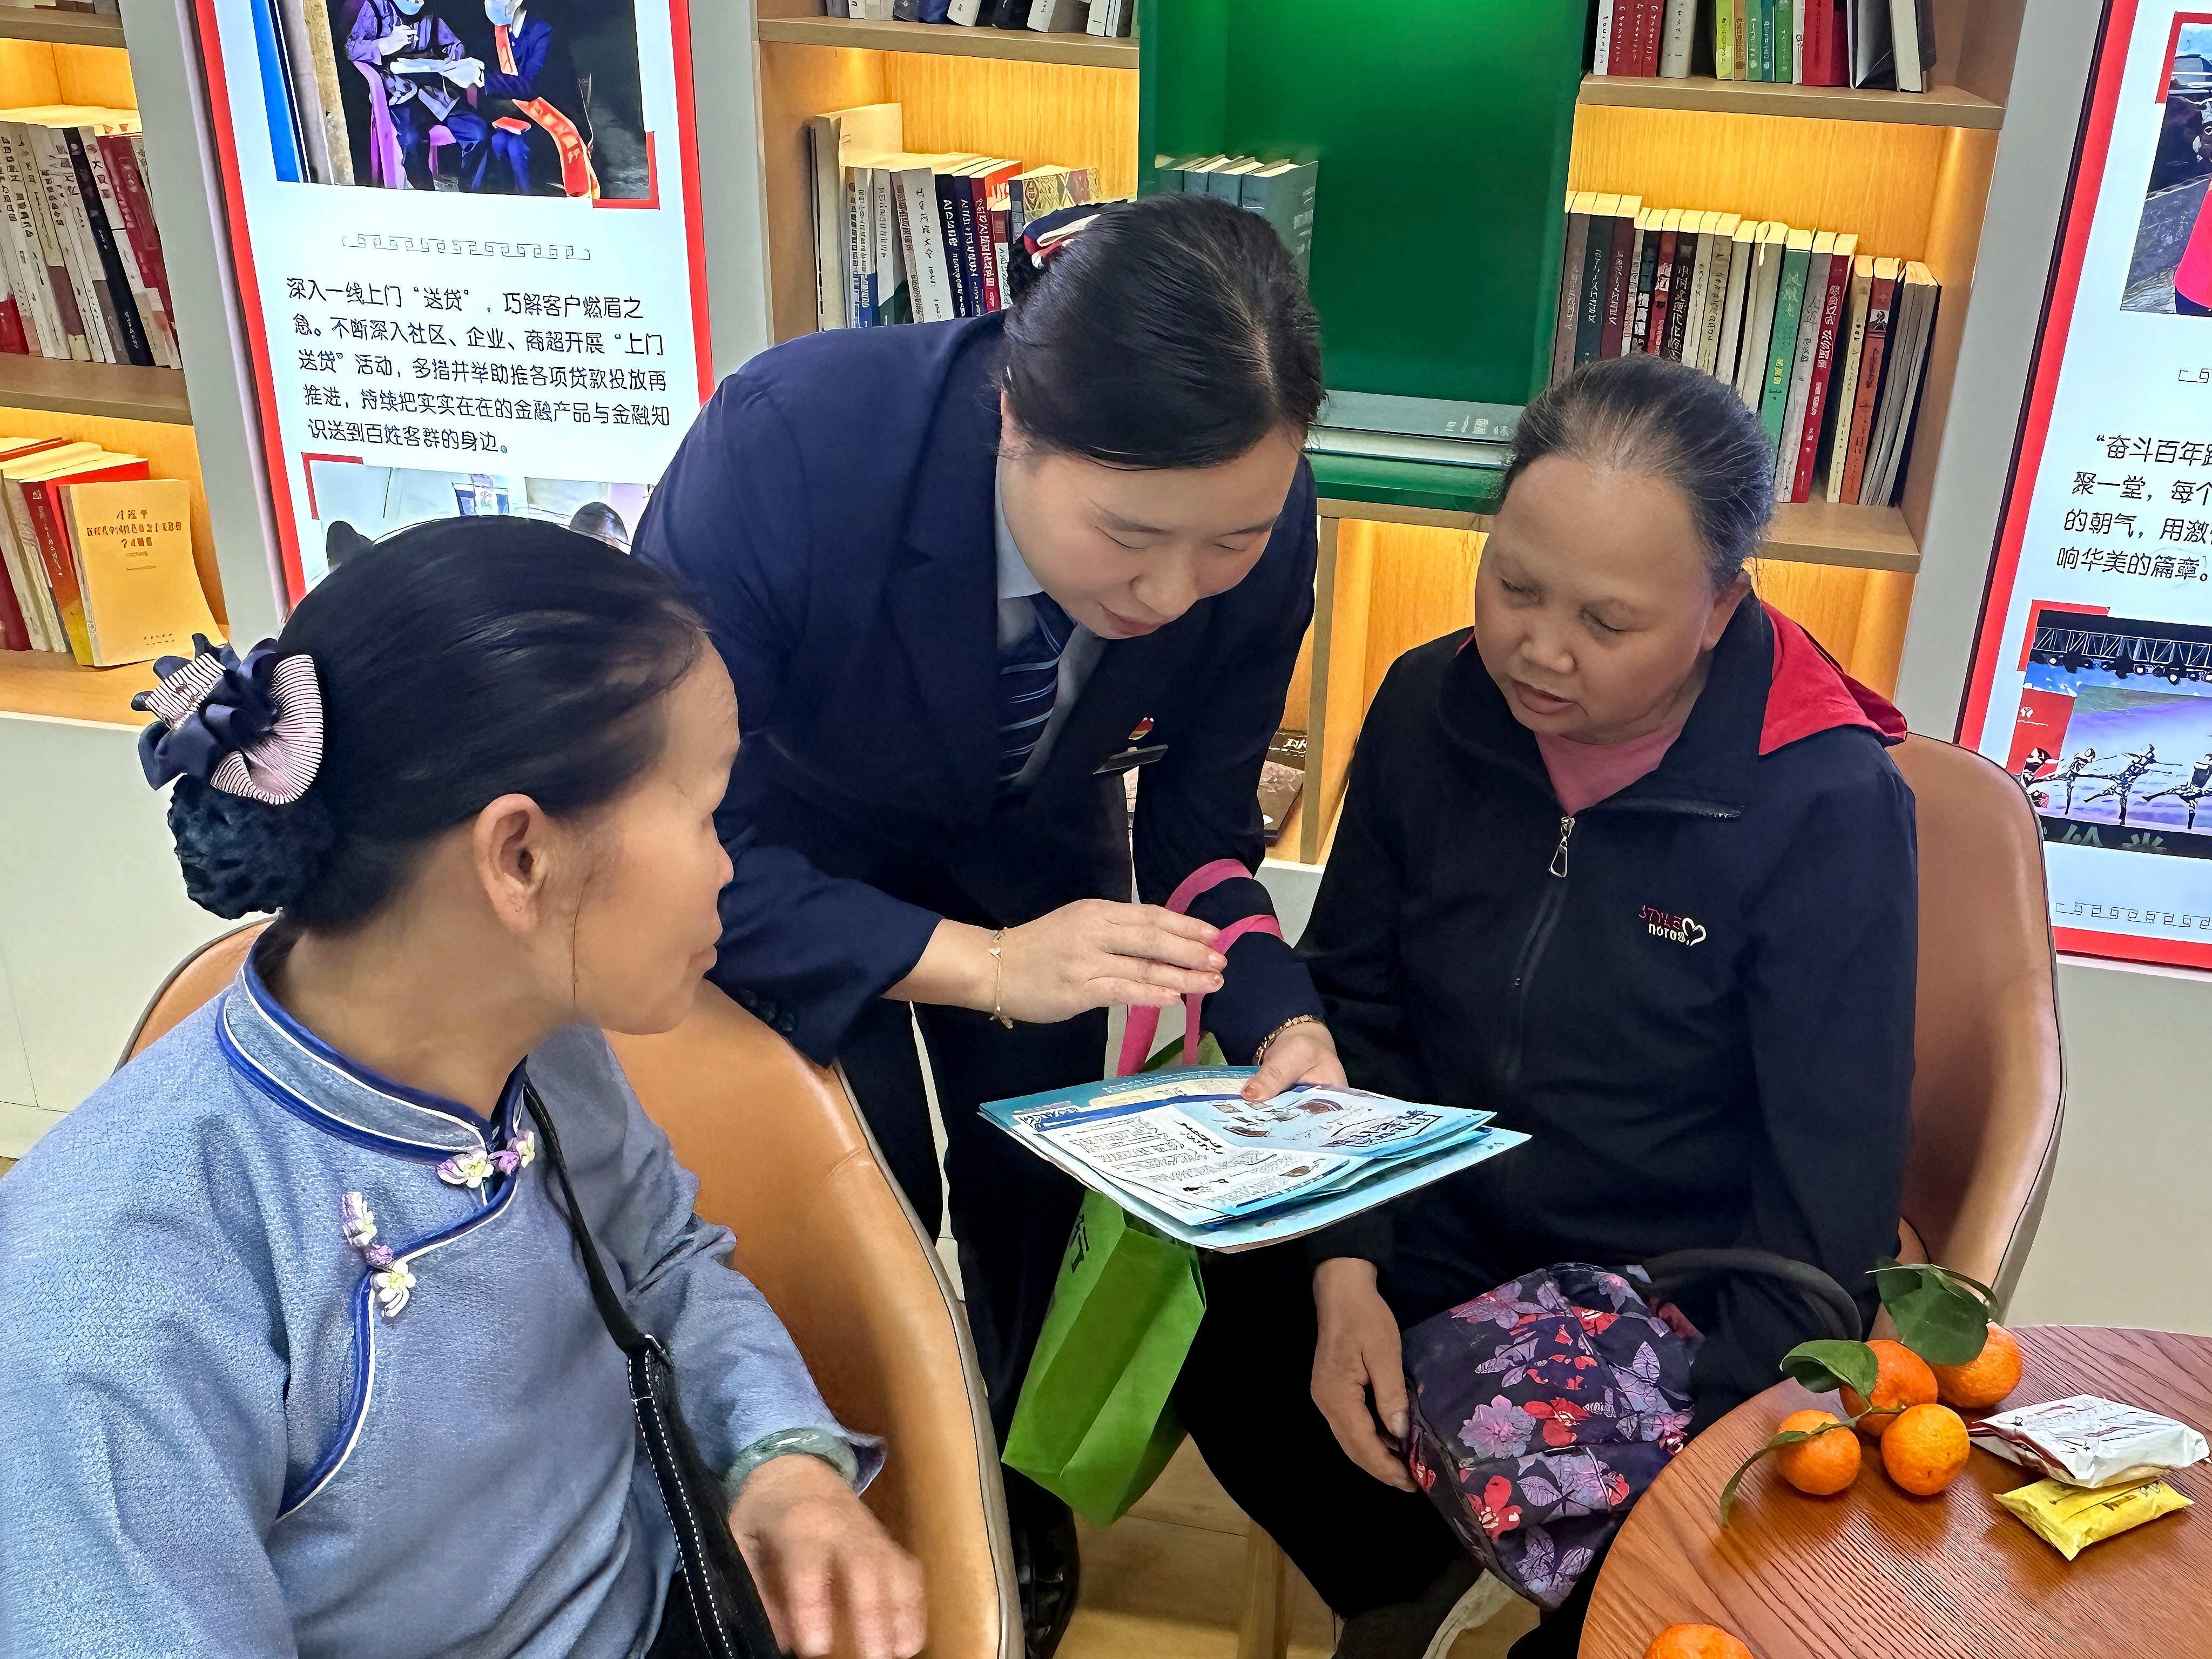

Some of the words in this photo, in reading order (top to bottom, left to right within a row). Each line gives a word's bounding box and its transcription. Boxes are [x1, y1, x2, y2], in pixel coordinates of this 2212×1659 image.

[308, 419, 507, 453] 识送到百姓客群的身边。
[2064, 509, 2212, 544] 的朝气，用激
[2057, 547, 2208, 581] 响华美的篇章。
